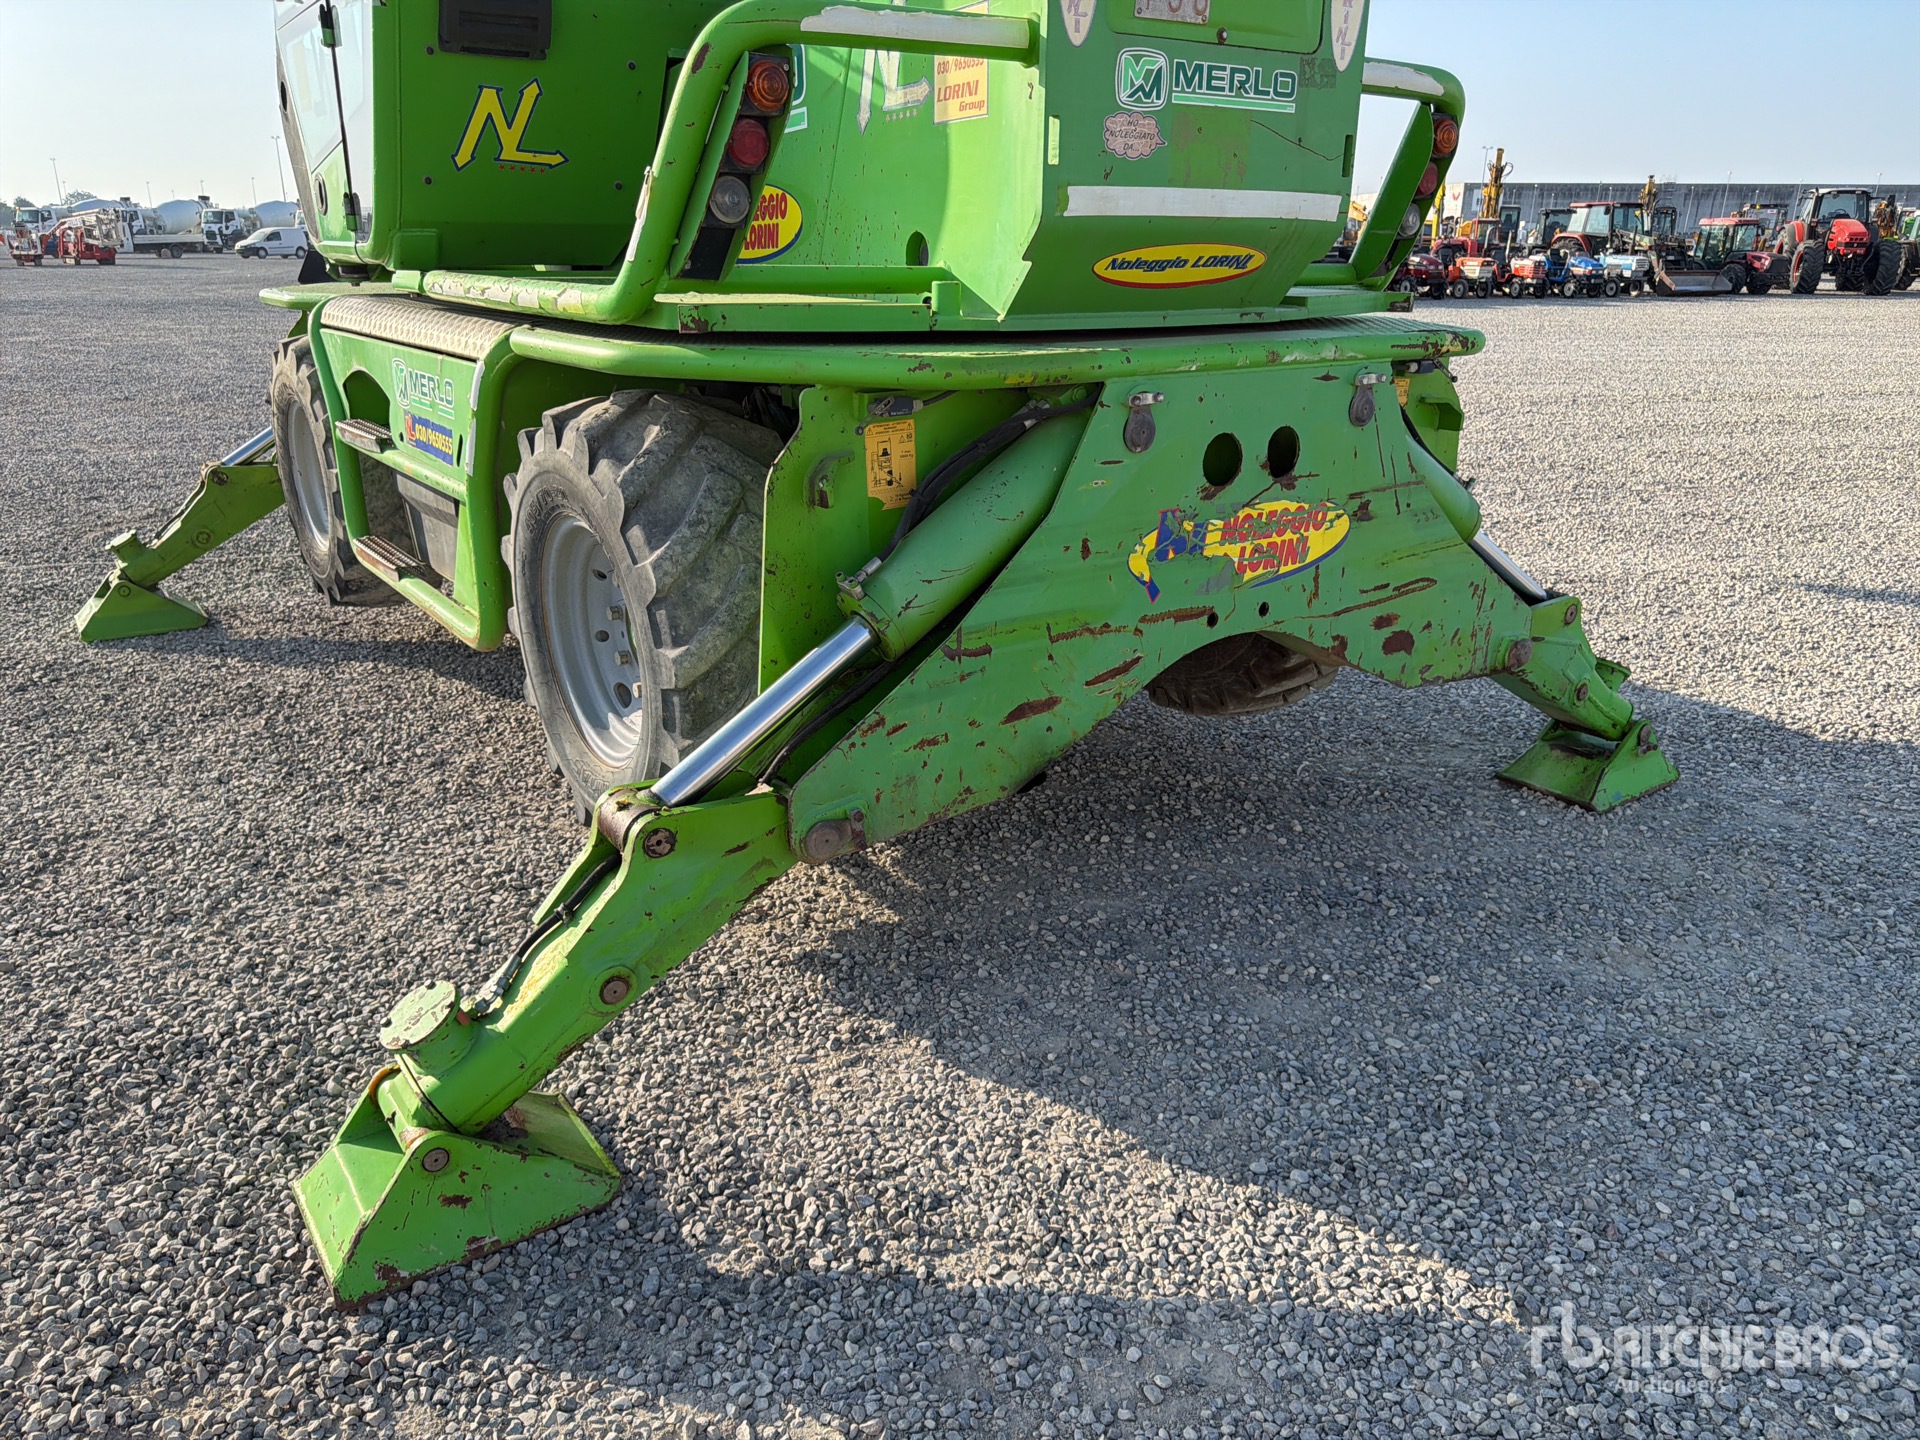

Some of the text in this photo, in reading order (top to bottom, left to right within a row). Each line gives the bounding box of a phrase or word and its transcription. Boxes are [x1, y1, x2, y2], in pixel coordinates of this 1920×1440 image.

[1172, 58, 1298, 101] MERLO
[936, 79, 979, 103] LORINI
[958, 99, 985, 112] Group
[1109, 130, 1156, 140] NOLEGGIATO
[1104, 256, 1190, 273] Noleggio
[408, 367, 455, 408] MERLO
